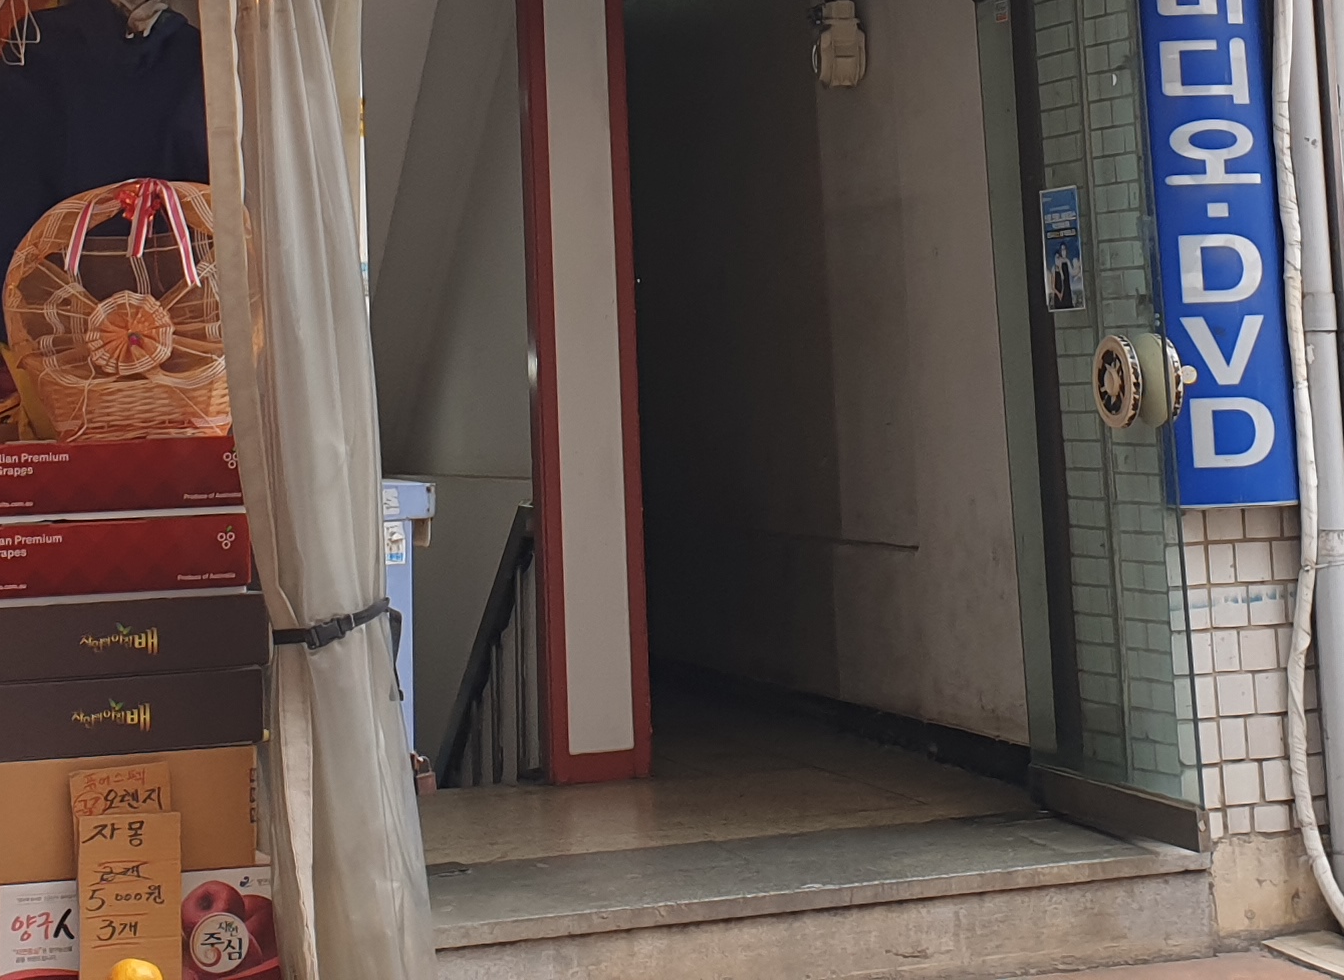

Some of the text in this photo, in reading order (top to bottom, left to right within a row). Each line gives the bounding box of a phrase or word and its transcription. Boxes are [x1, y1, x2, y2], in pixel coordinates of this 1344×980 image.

[21, 451, 69, 463] Premium
[14, 534, 63, 546] Premium
[104, 786, 164, 812] 오렌지
[81, 820, 145, 848] 자몽
[96, 919, 139, 942] 3개
